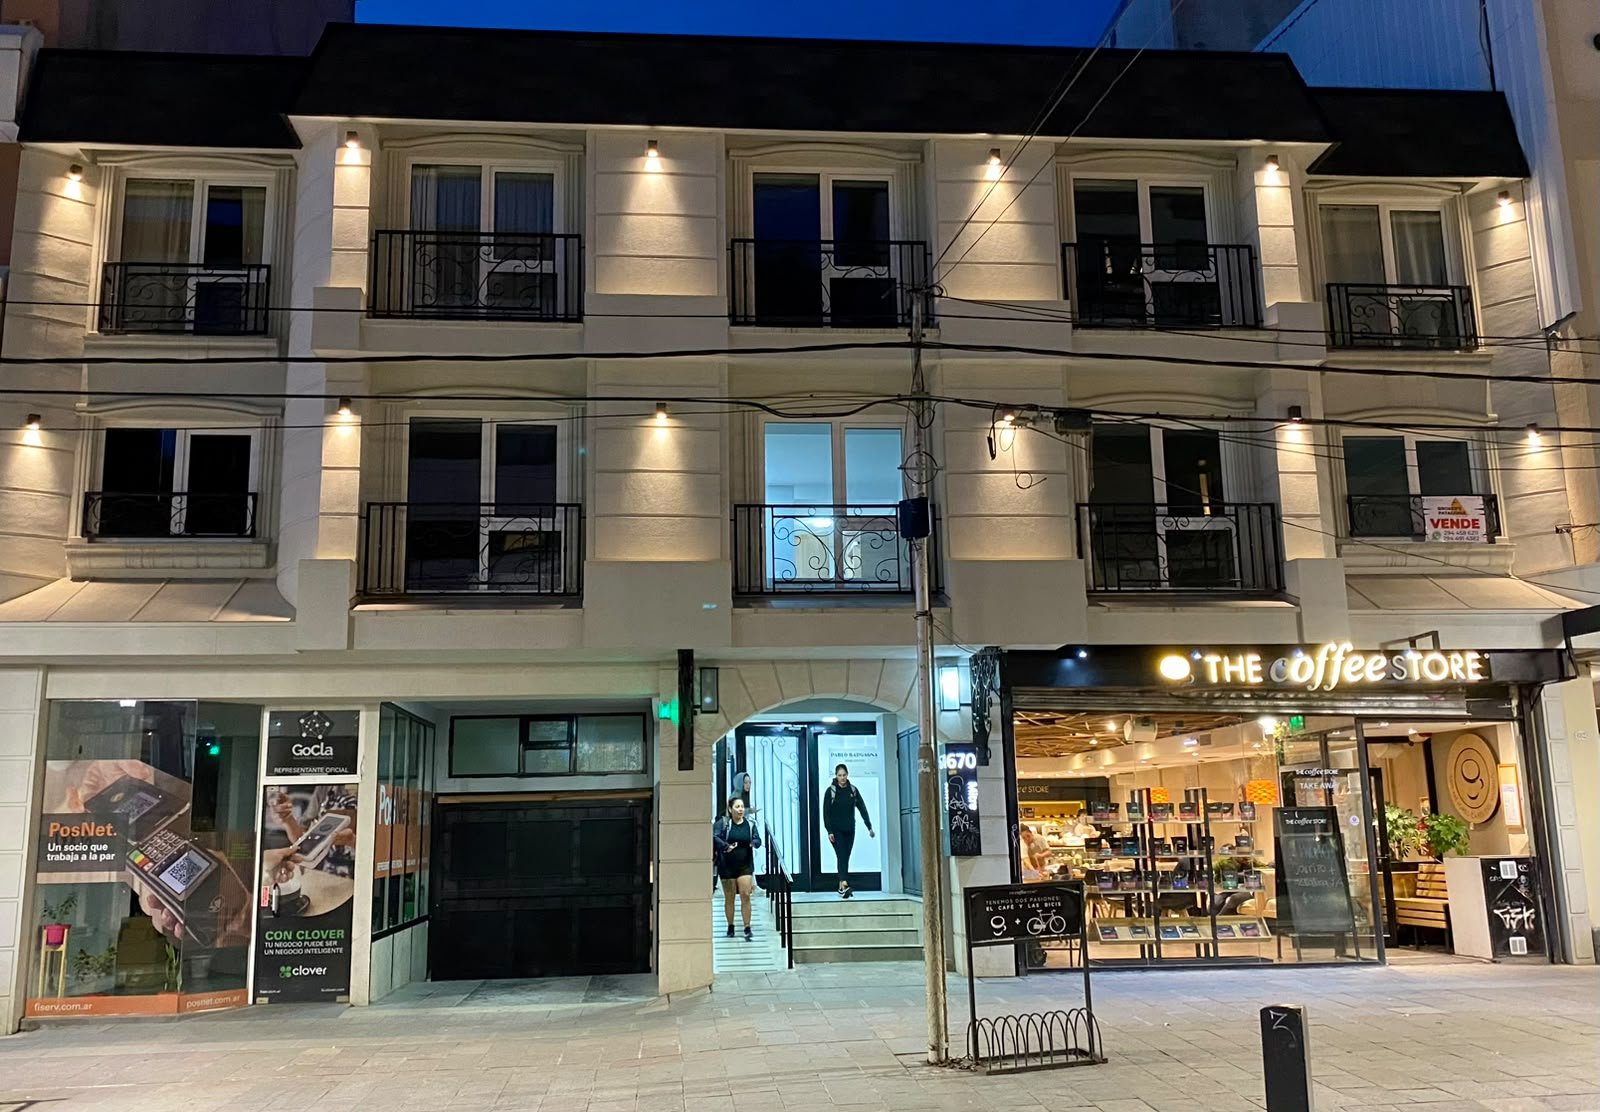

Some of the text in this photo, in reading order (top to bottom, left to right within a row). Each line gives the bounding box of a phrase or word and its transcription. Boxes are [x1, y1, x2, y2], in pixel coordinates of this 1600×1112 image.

[1430, 518, 1480, 529] VENDE
[1205, 641, 1485, 692] THE coffee STORE
[291, 742, 334, 757] GoCla
[946, 752, 977, 770] 670
[273, 766, 324, 774] REPRESENTANTE
[1304, 767, 1324, 777] coffee
[1028, 785, 1049, 793] STORE
[1294, 817, 1312, 826] coffee
[48, 822, 117, 837] PosNet.
[47, 842, 108, 852] Un socio que
[47, 852, 115, 862] trabaja a la par
[265, 929, 345, 941] CON CLOVER
[292, 965, 327, 976] clover
[34, 1002, 93, 1012] fiserv.com.ar
[186, 994, 241, 1009] posnet.com.ar
